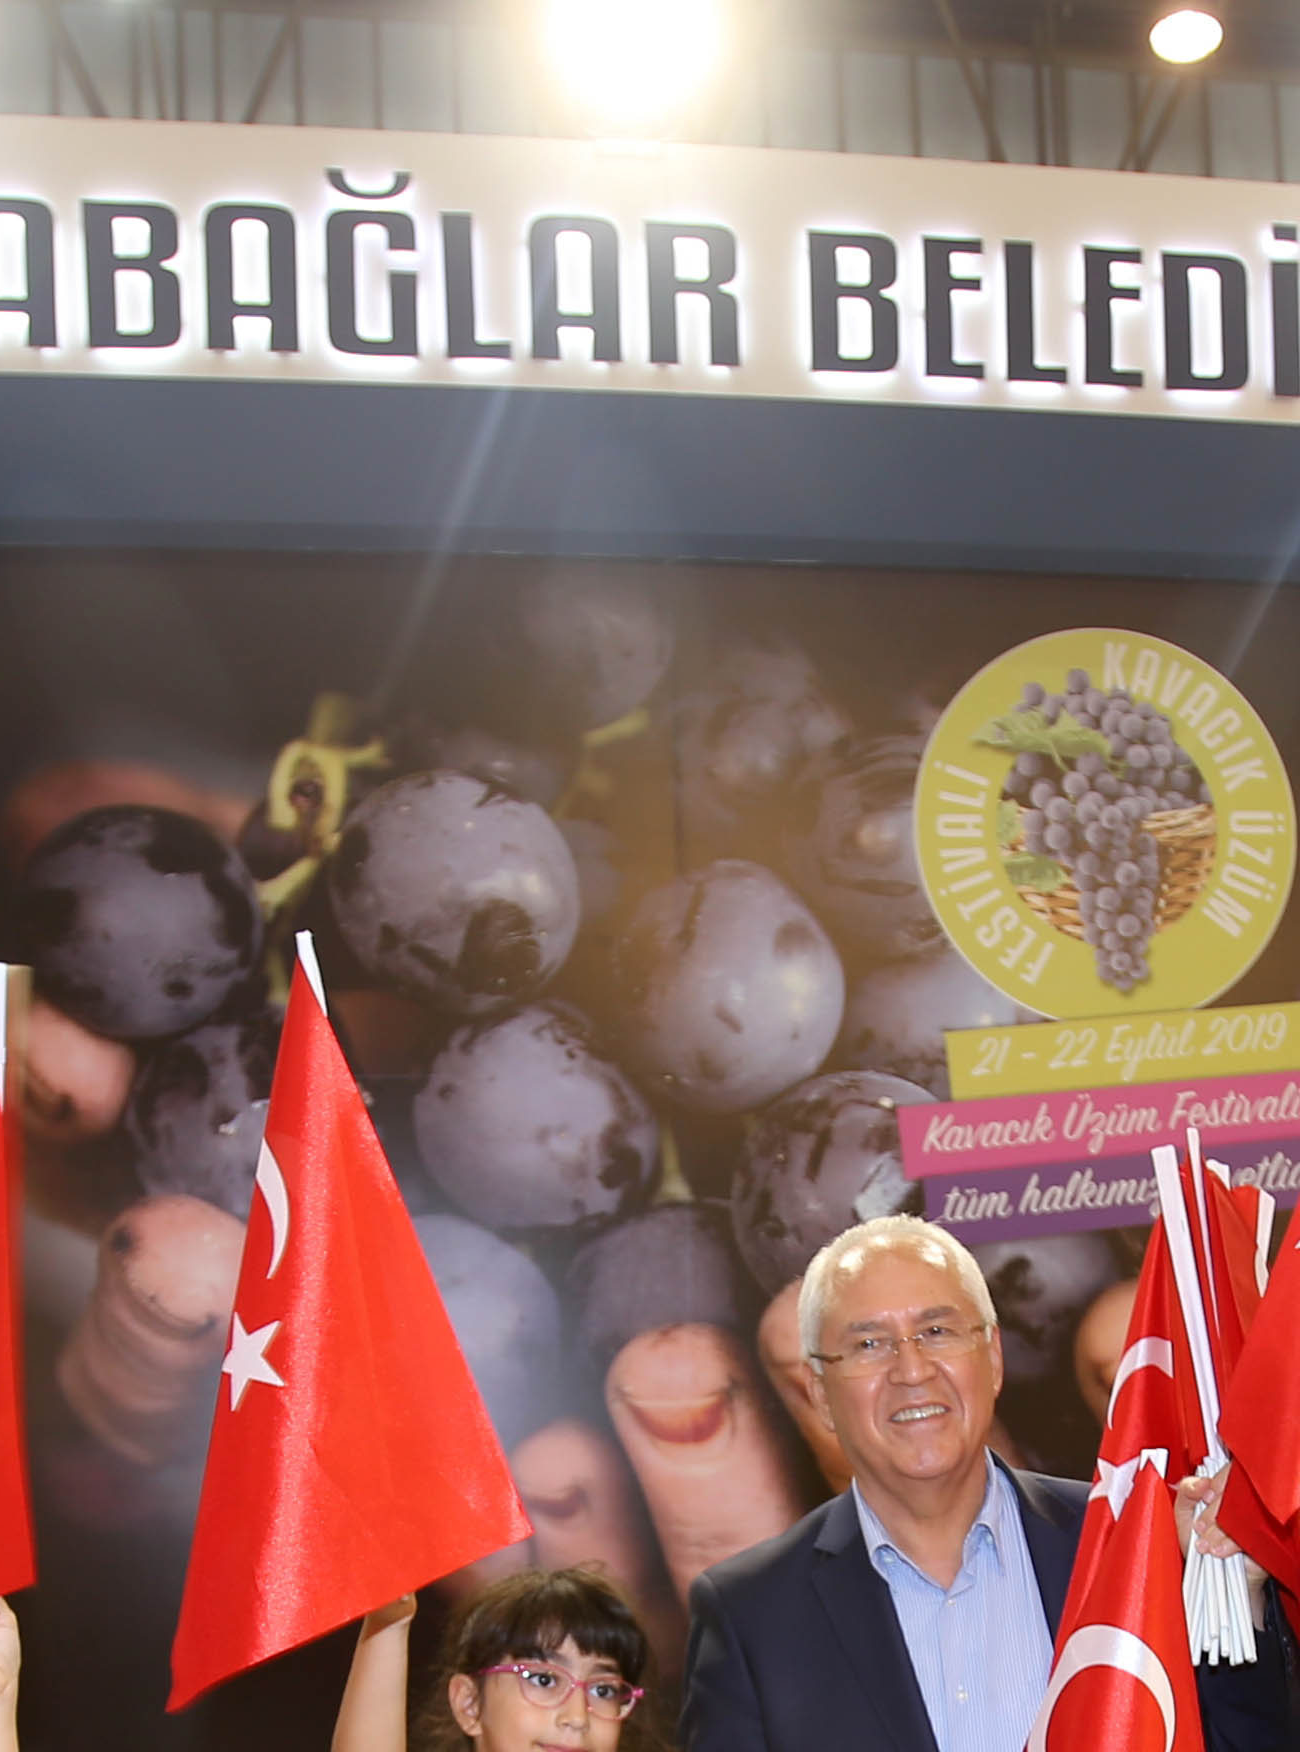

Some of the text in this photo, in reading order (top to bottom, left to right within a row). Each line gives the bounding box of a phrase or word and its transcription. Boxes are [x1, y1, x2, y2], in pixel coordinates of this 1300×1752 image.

[1102, 642, 1285, 938] KAVACIK ÜZÜM
[934, 760, 1055, 986] FESTİVALİ
[971, 1035, 1011, 1077] 21
[1049, 1029, 1099, 1070] 22
[1104, 1020, 1197, 1082] Eylül
[1202, 1011, 1289, 1057] 2019
[922, 1102, 1054, 1154] Kavacık
[1062, 1095, 1162, 1154] Üzüm
[942, 1184, 1013, 1222] tüm
